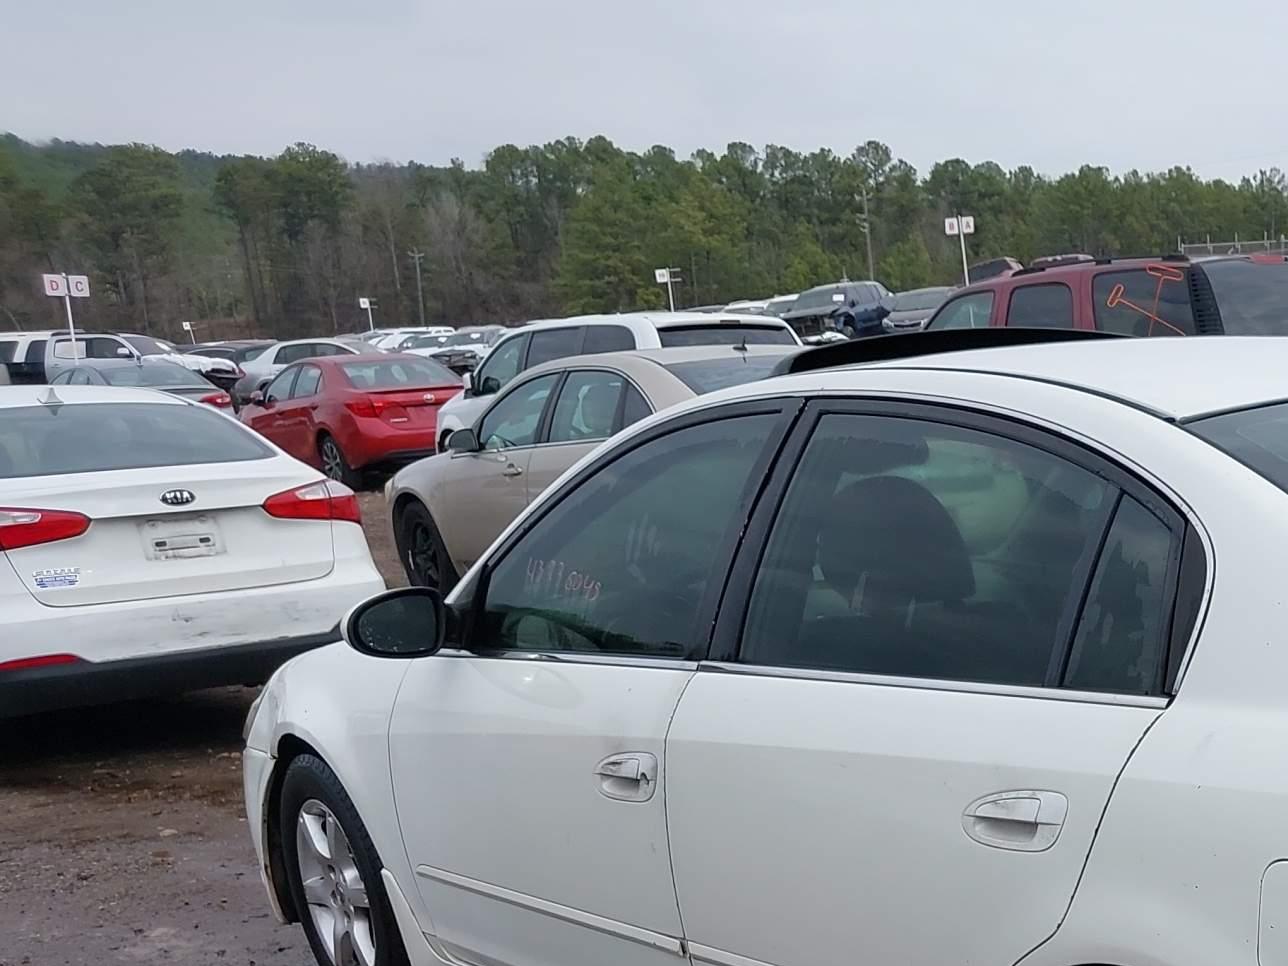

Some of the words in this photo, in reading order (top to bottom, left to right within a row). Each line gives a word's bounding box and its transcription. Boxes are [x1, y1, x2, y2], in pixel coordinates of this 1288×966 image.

[50, 280, 59, 291] D
[75, 281, 84, 292] C
[165, 491, 192, 503] KIA
